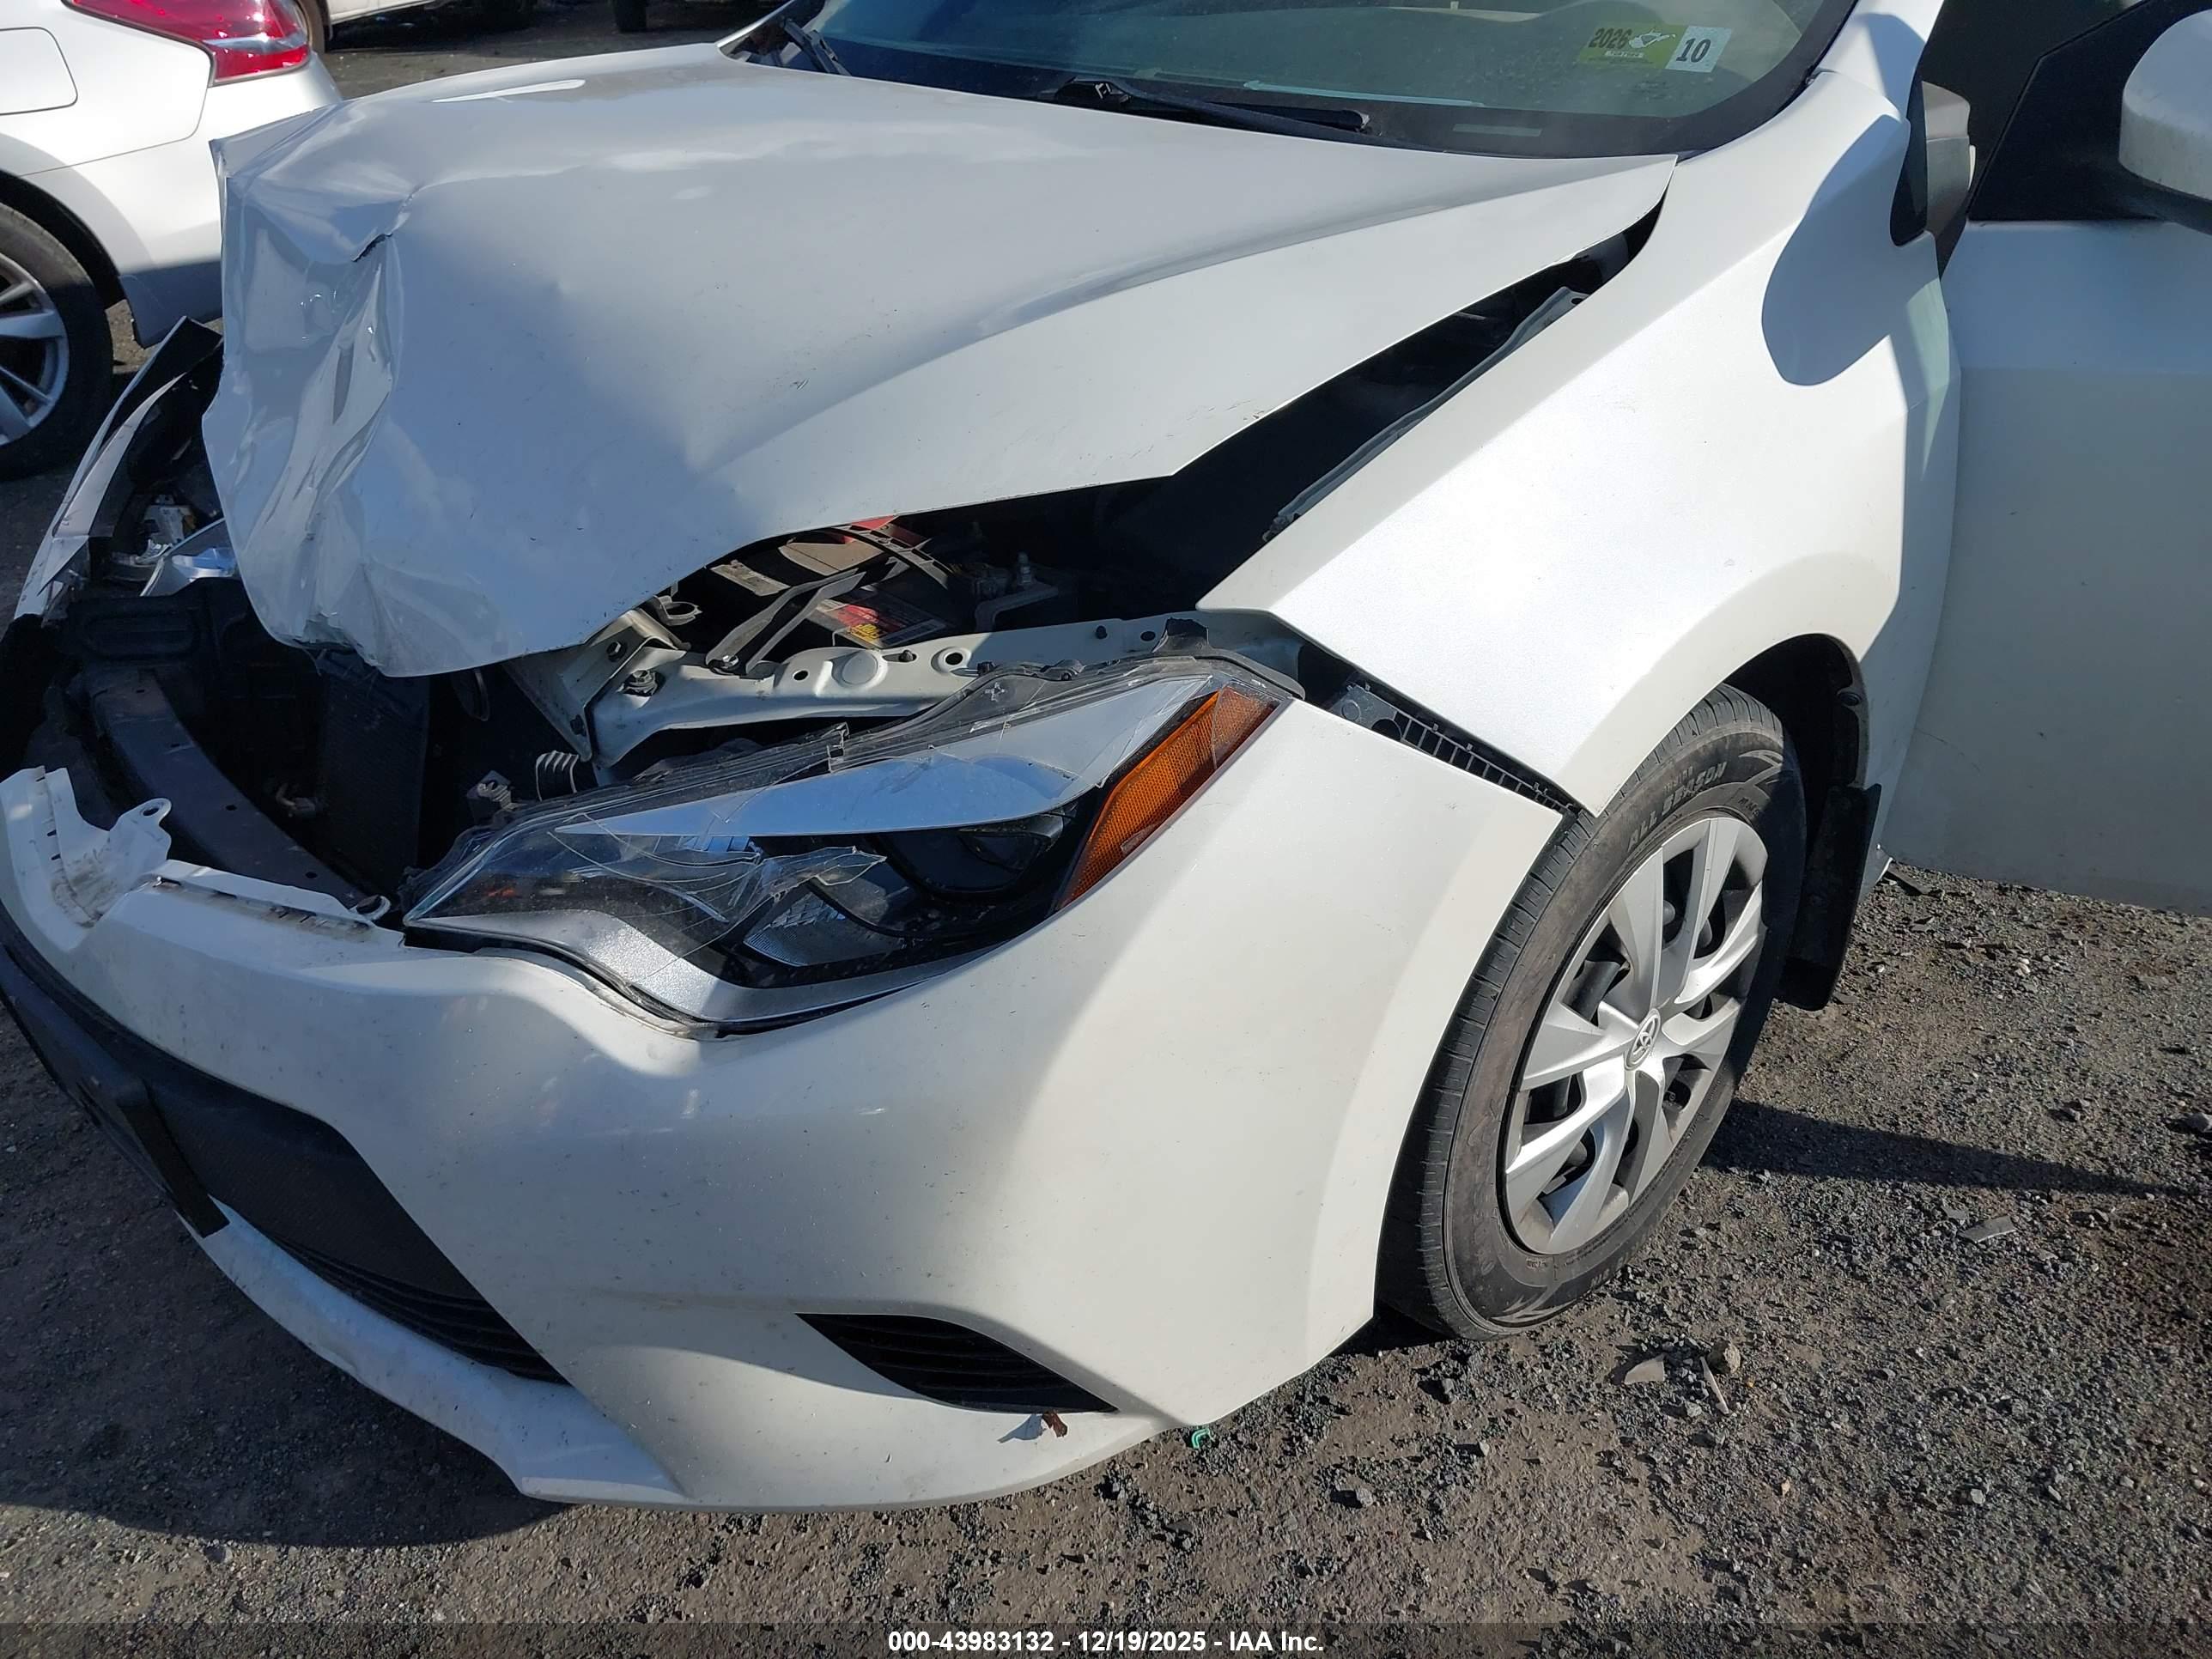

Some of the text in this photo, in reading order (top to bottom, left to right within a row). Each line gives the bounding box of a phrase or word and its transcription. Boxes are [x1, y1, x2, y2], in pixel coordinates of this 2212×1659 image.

[1589, 27, 1632, 49] 2026
[1675, 38, 1711, 63] 10
[1627, 810, 1658, 854] ALL
[1662, 761, 1728, 817] SEASON
